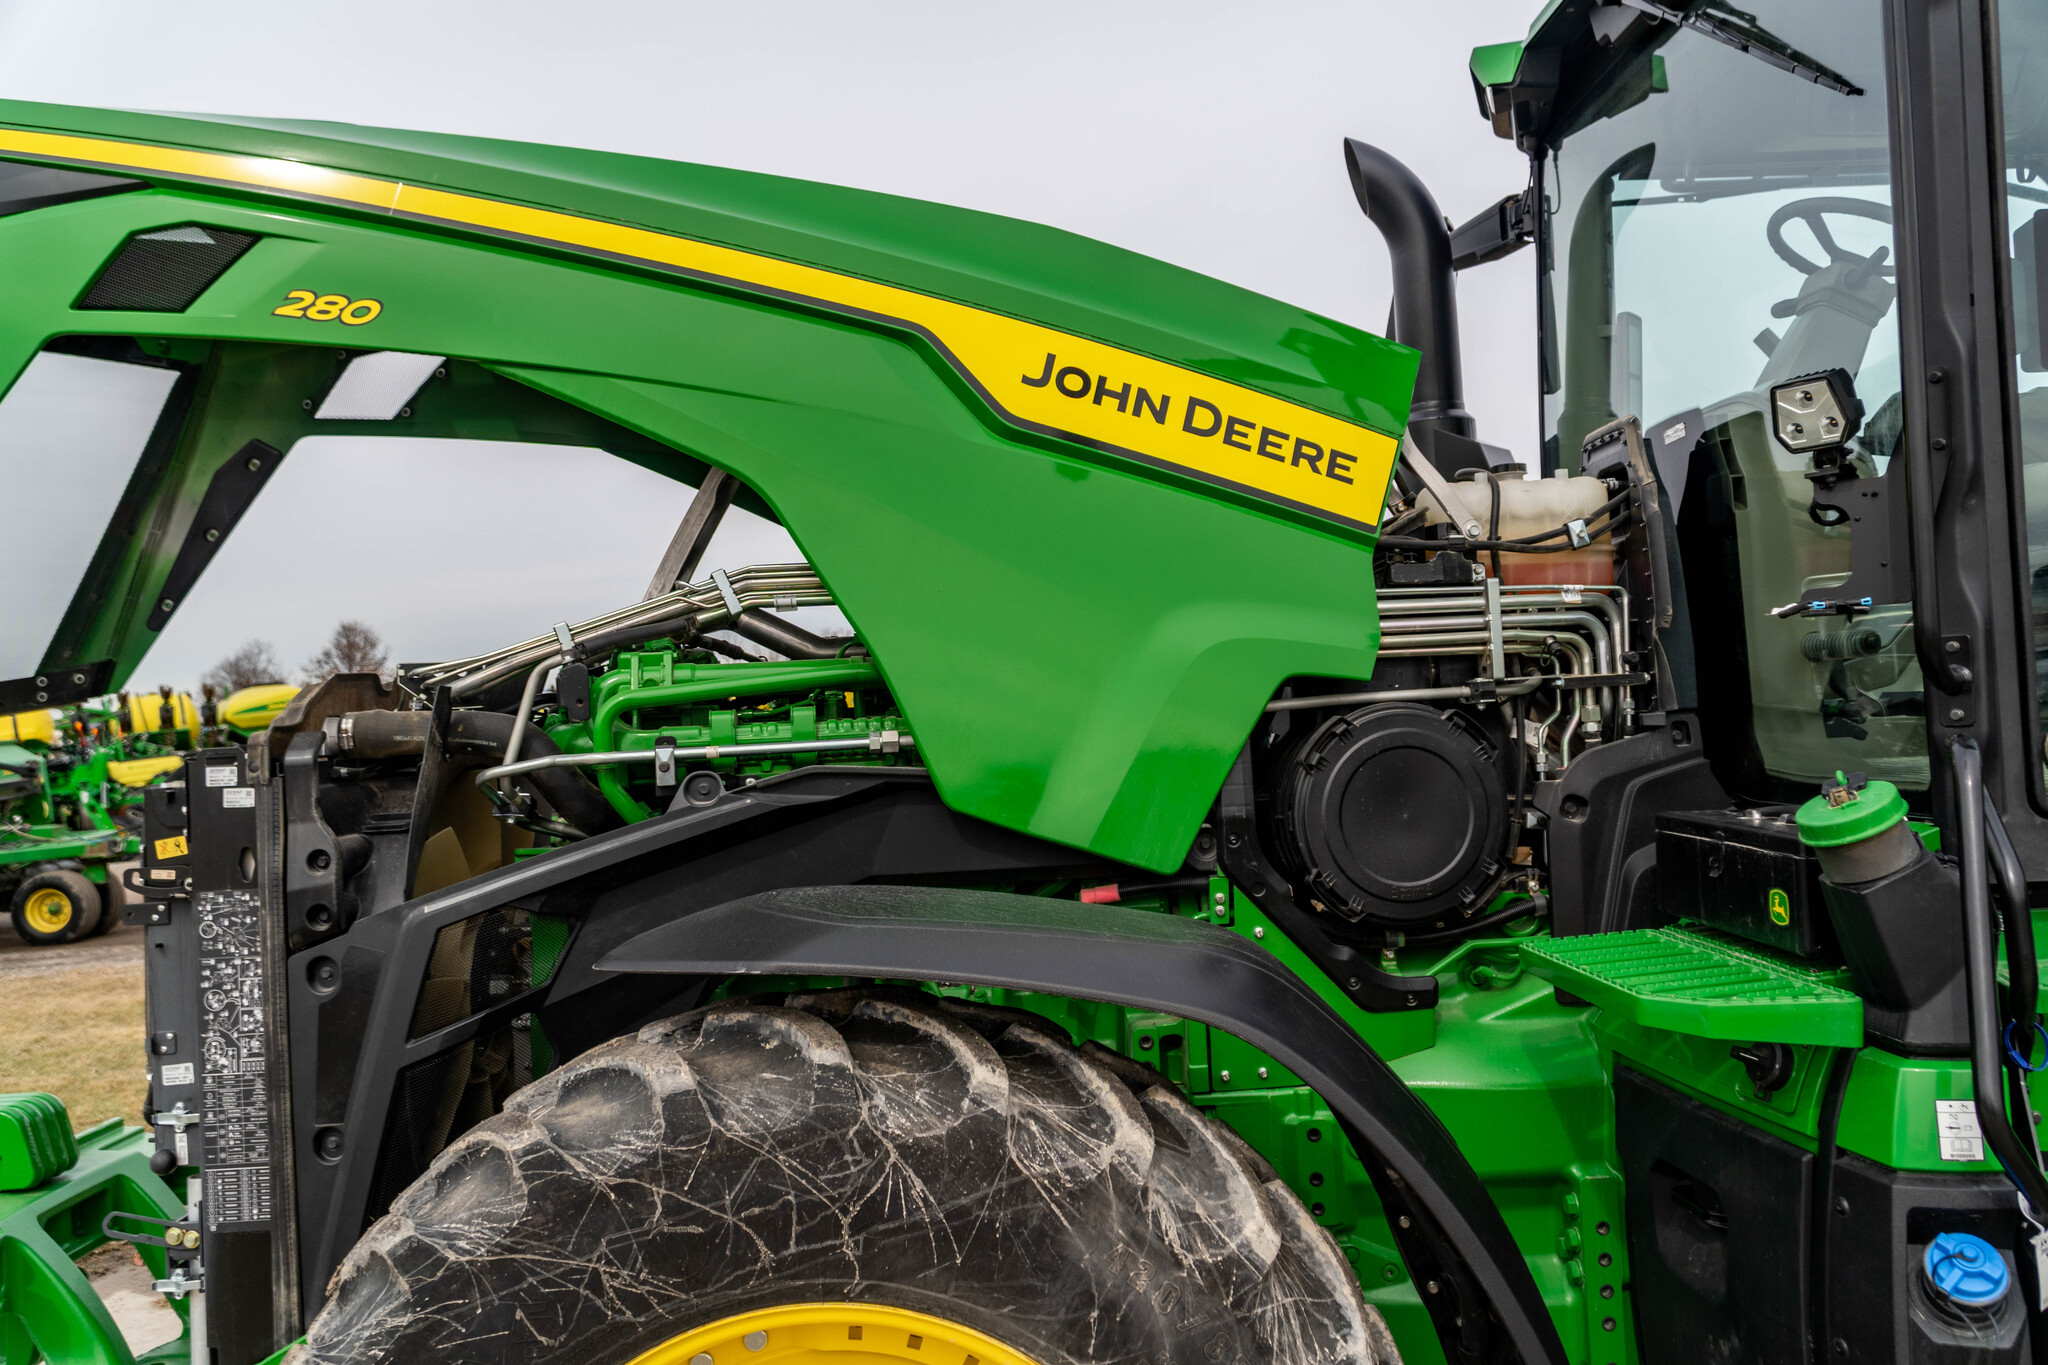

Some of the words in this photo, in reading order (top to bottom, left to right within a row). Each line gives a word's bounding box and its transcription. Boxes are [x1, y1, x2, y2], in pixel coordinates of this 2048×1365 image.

[270, 288, 384, 326] 280
[1020, 352, 1171, 425] JOHN
[1181, 395, 1358, 486] DEERE
[1104, 1243, 1252, 1365] 420/8
